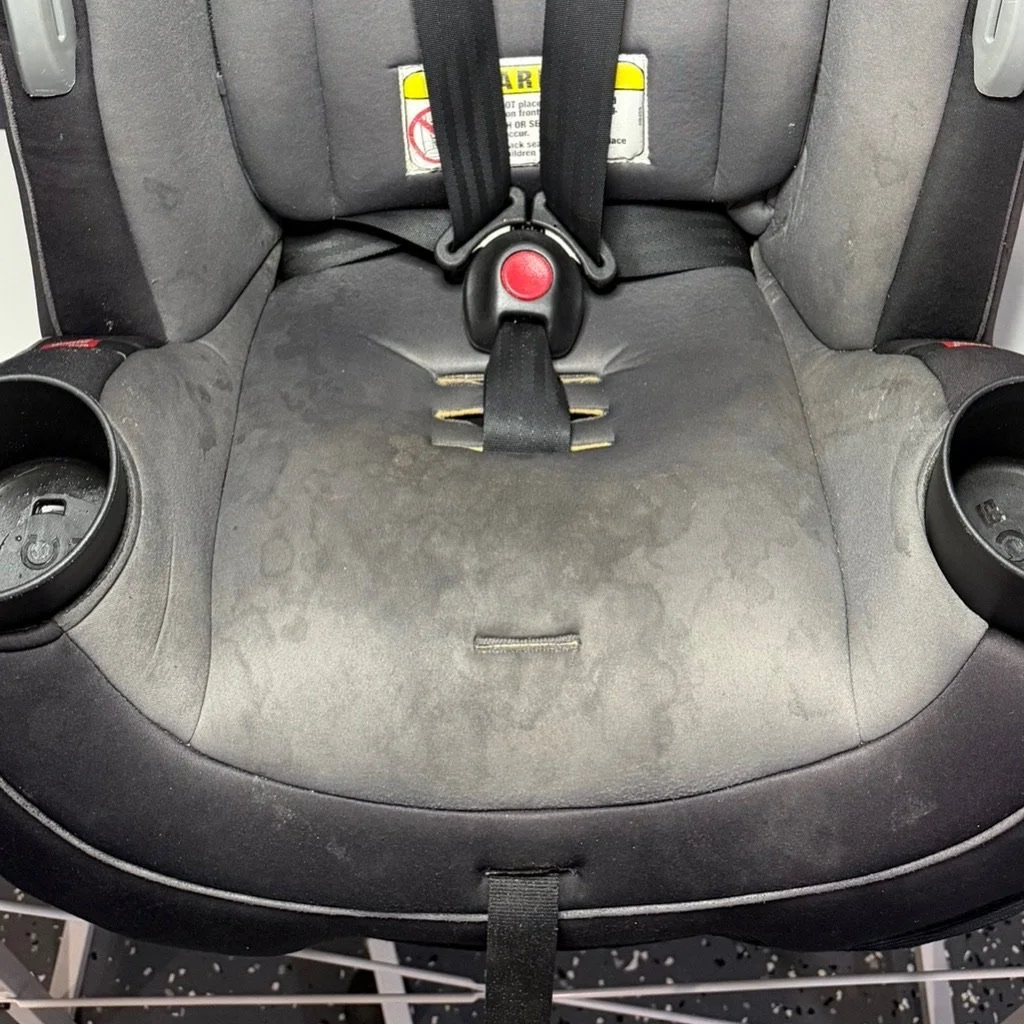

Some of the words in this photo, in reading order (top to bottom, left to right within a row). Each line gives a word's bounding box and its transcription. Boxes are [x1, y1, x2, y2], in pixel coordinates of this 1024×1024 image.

[501, 70, 540, 90] AR
[505, 100, 516, 109] OT
[514, 120, 526, 128] OR
[509, 140, 524, 148] ack
[510, 149, 536, 157] ildren
